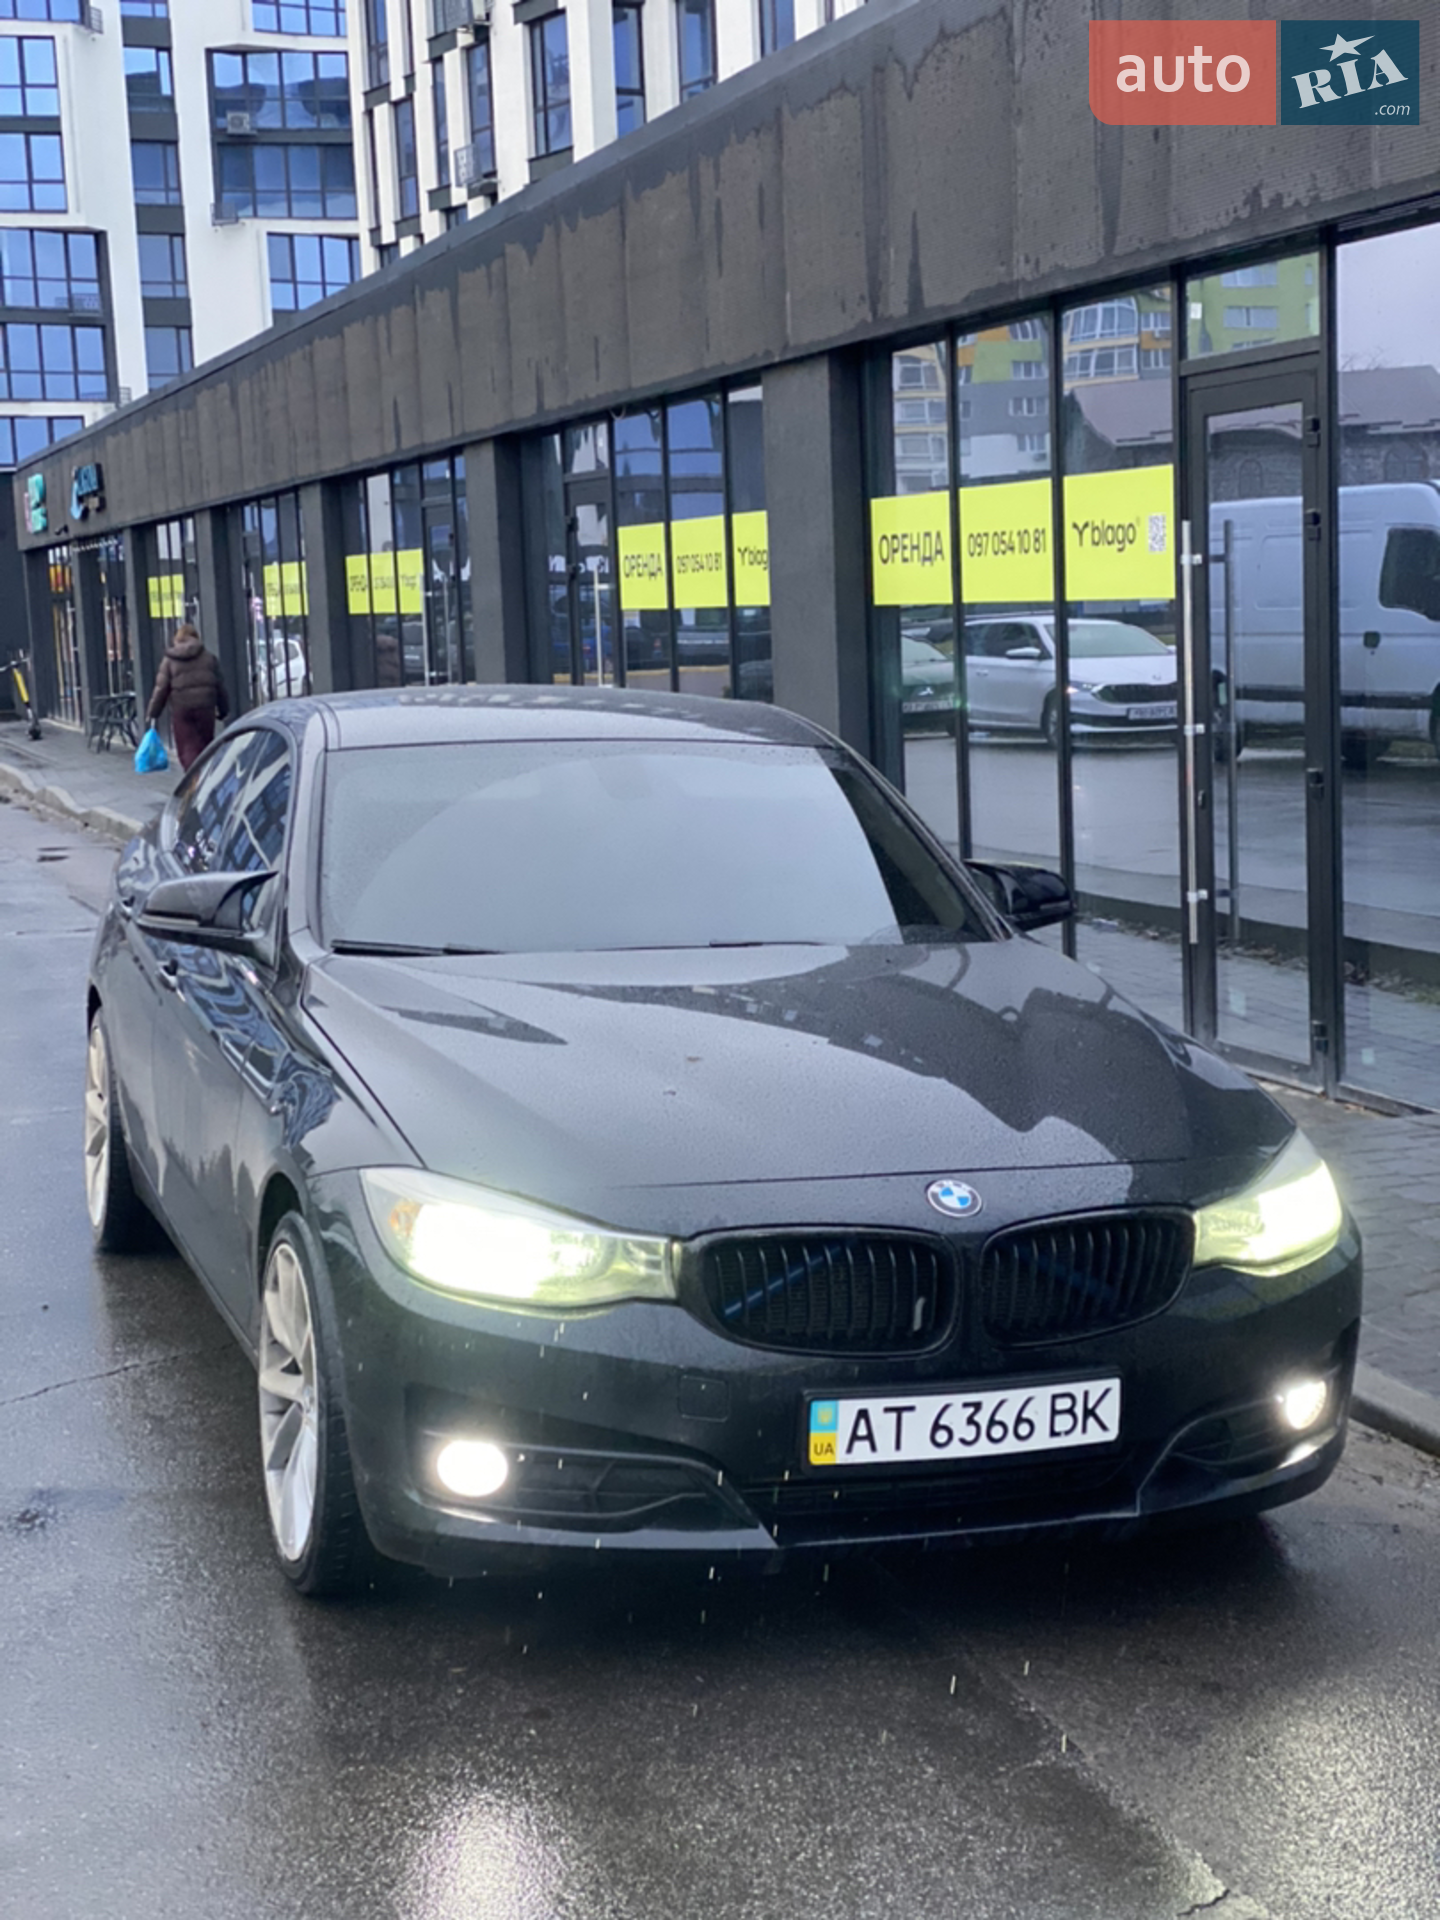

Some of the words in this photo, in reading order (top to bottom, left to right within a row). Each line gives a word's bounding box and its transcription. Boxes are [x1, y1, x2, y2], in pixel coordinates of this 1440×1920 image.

[878, 530, 945, 567] ОРЕНДА
[967, 531, 989, 558] 097
[991, 530, 1015, 556] 054
[1033, 527, 1047, 554] 81
[845, 1405, 916, 1454] AT
[929, 1396, 1037, 1450] 6366
[1048, 1387, 1113, 1438] BK
[813, 1443, 834, 1456] UA
